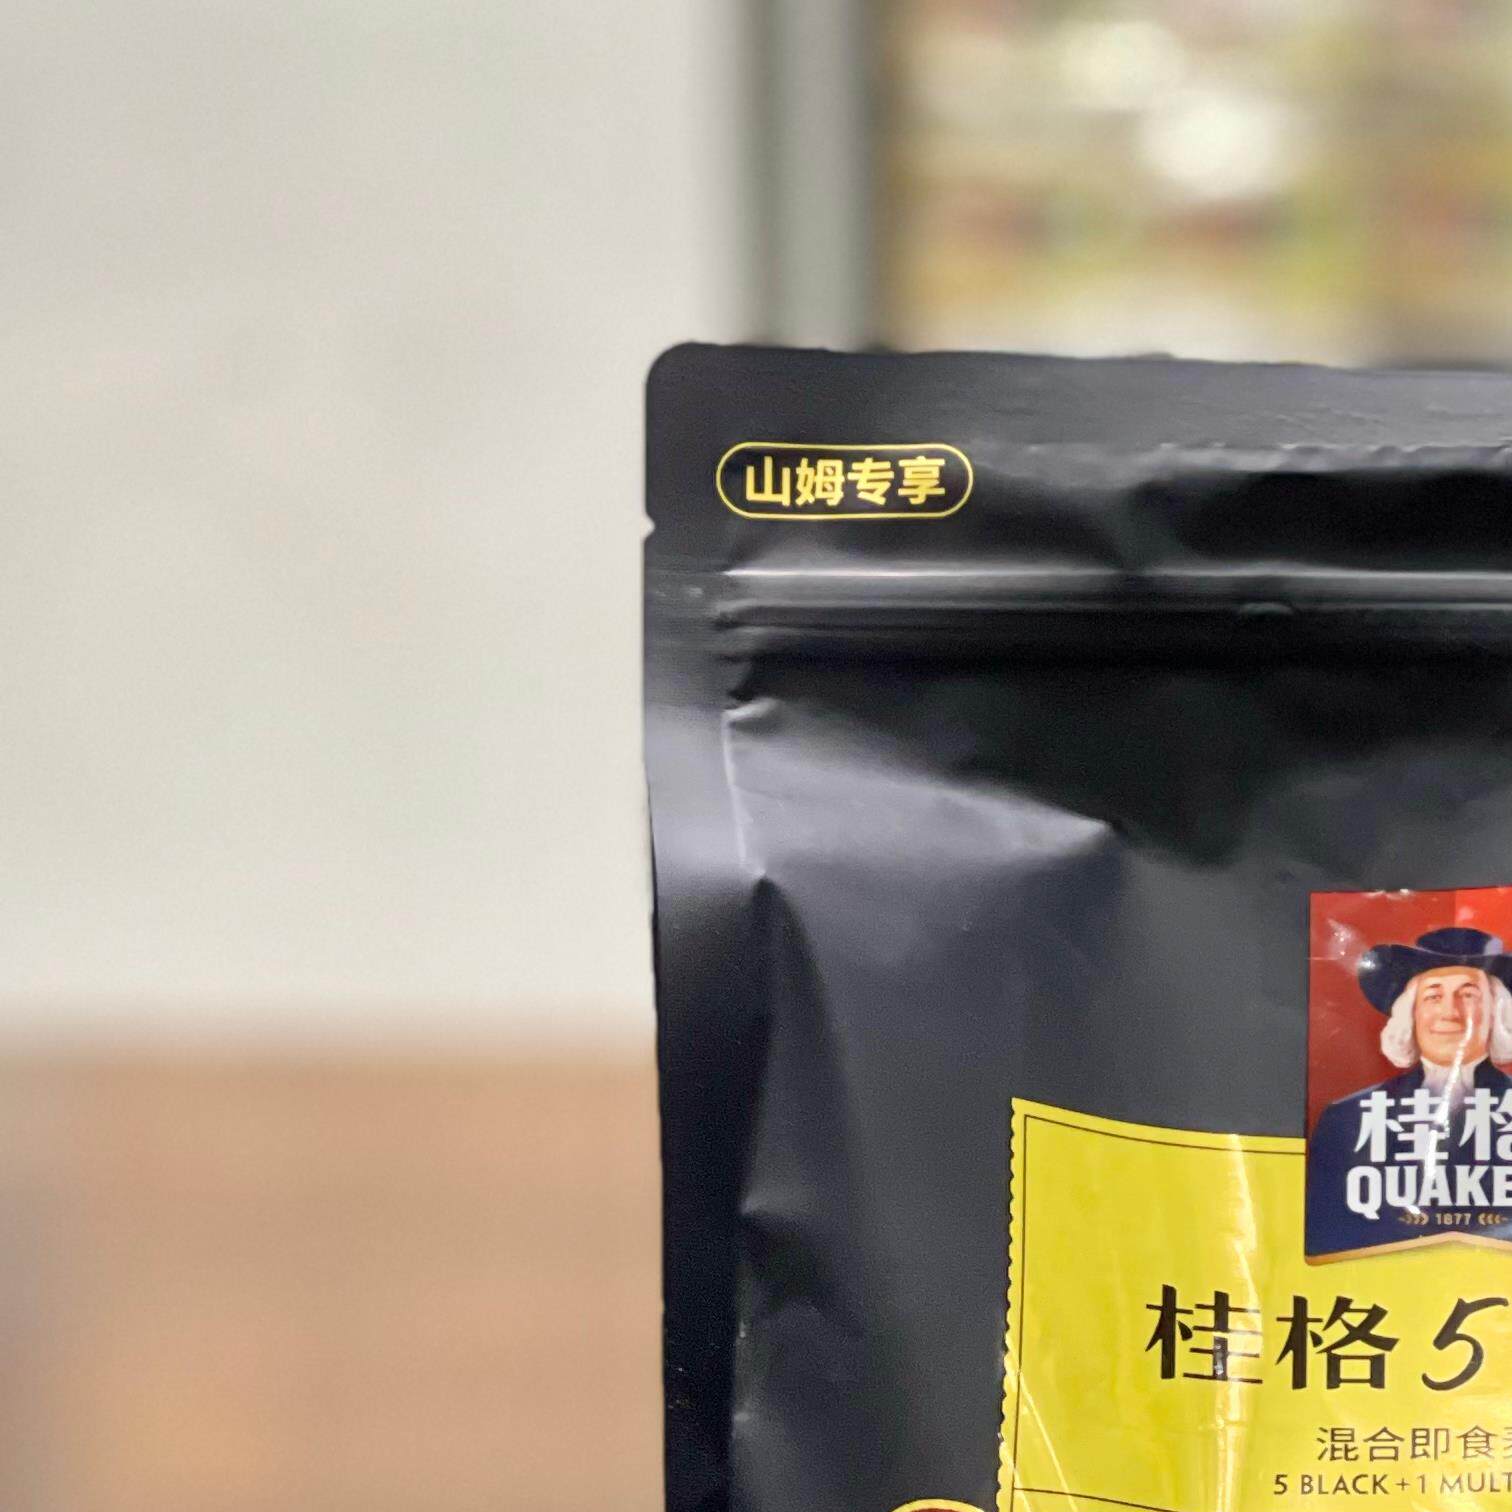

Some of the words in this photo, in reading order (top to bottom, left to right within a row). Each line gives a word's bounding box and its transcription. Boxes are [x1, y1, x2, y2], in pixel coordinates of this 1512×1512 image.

[745, 456, 946, 506] 山姆专享
[1436, 1213, 1471, 1225] 1877
[1274, 1475, 1288, 1495] 5
